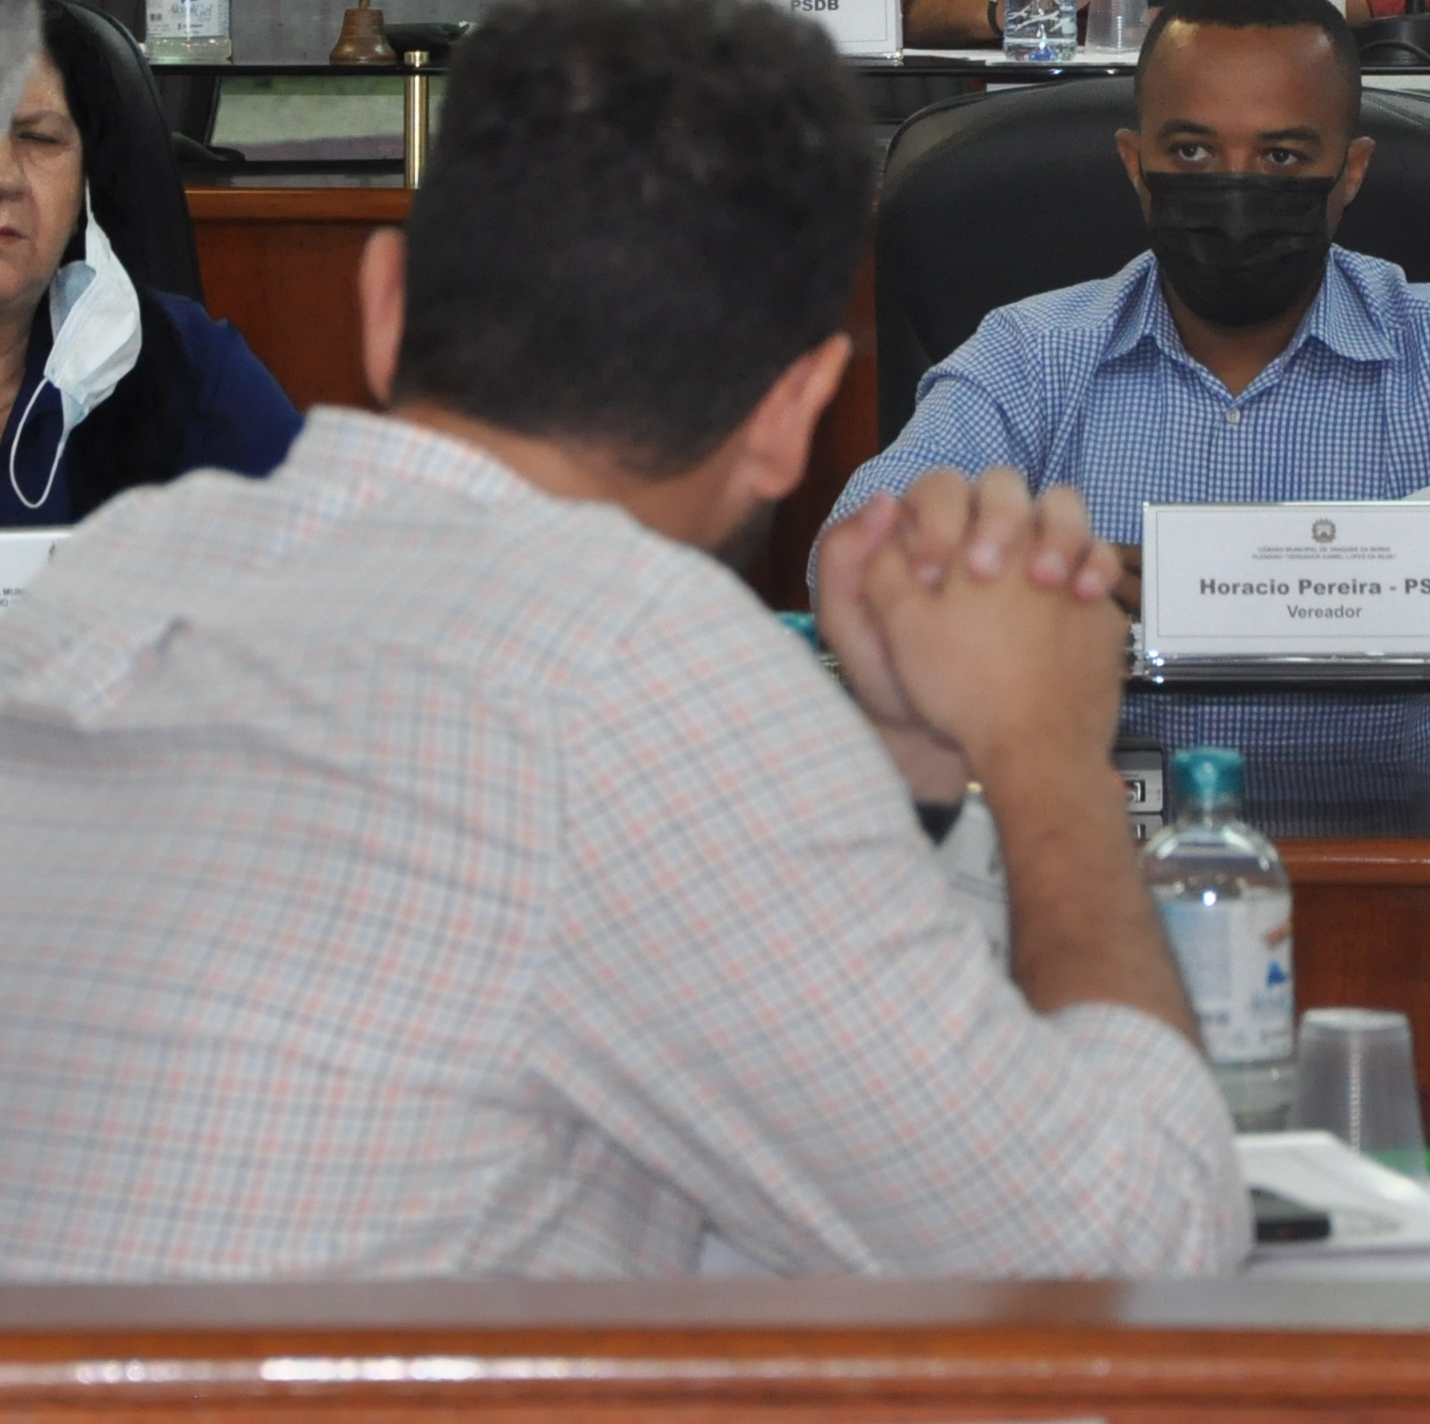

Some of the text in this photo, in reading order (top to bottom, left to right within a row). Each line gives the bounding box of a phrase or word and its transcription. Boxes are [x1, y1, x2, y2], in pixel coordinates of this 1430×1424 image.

[1199, 578, 1290, 596] Horacio
[1298, 578, 1382, 596] Pereira
[1286, 605, 1363, 619] Vereador
